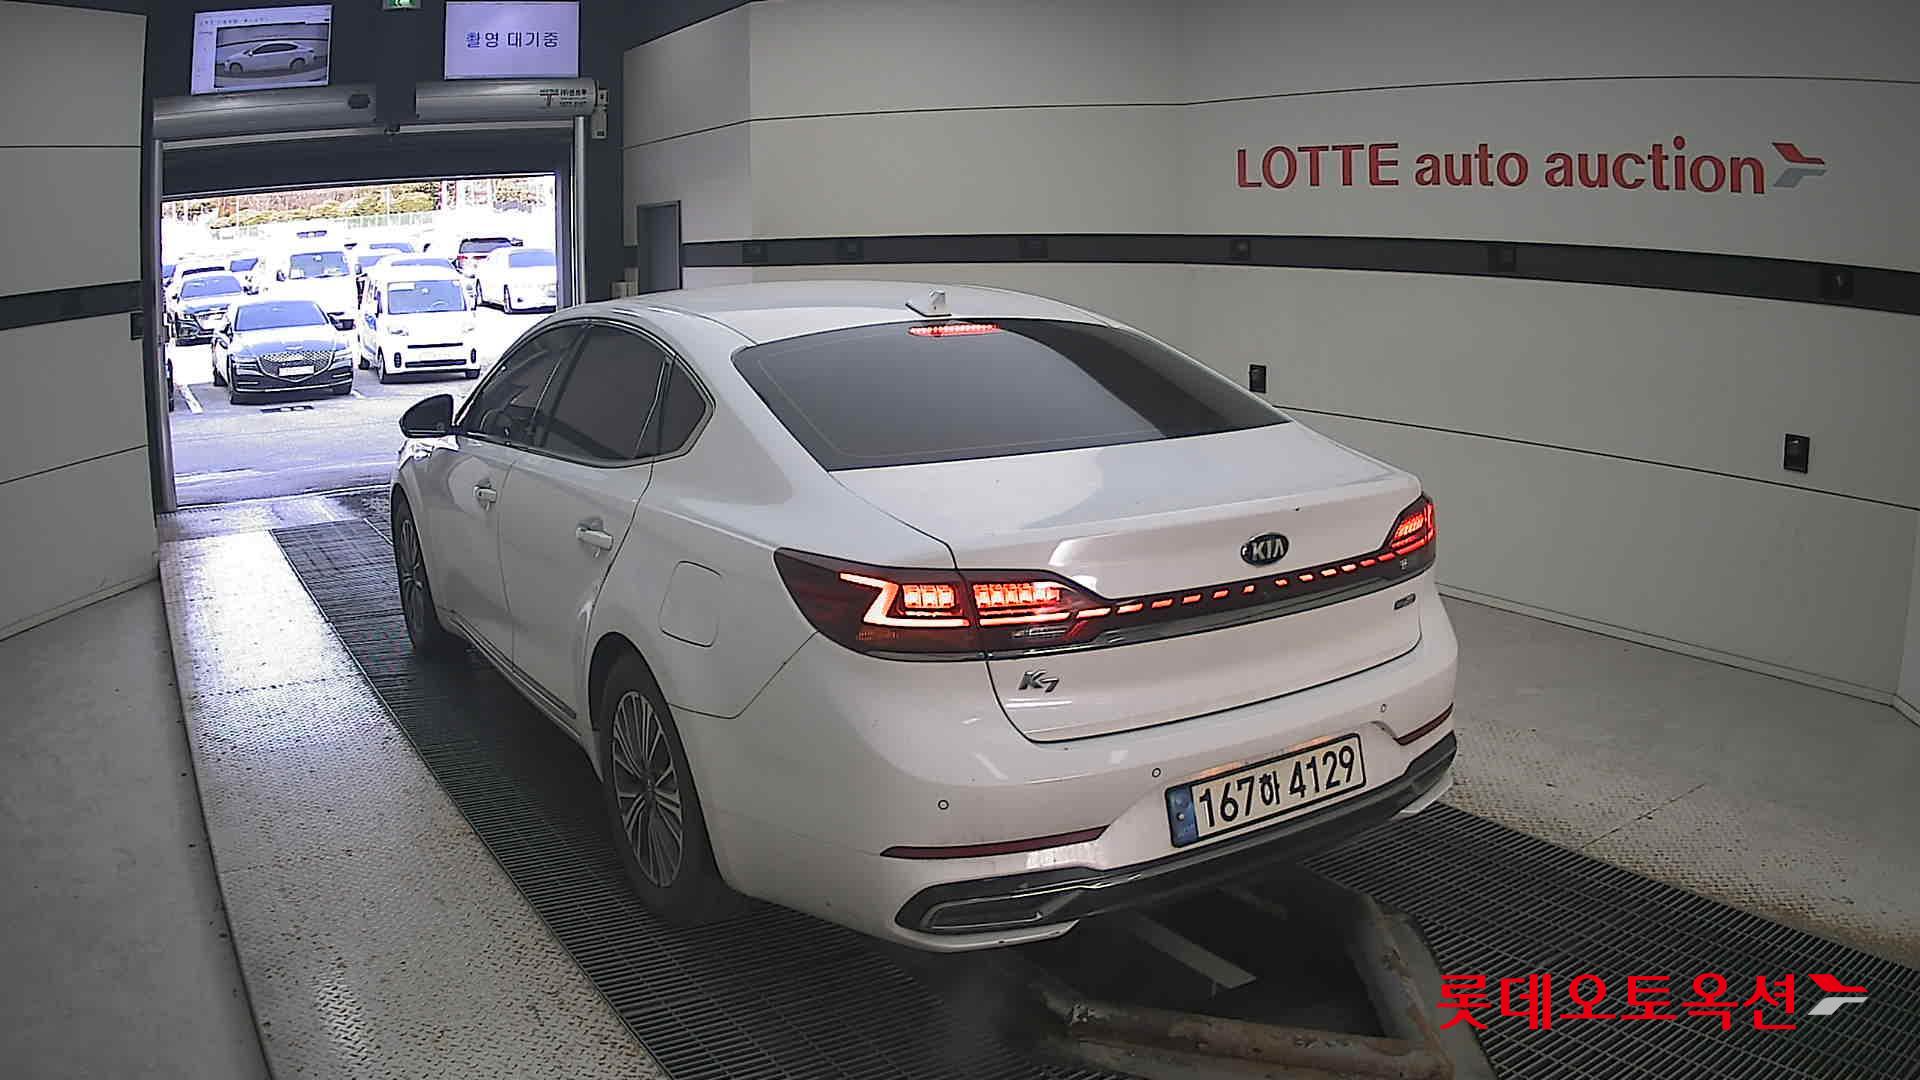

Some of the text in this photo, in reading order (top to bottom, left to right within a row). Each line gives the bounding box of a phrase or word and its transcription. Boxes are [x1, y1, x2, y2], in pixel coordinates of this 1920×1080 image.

[466, 32, 559, 48] 촬영 대기중
[1237, 136, 1766, 194] LOTTE auto auction
[1252, 539, 1285, 561] KIA
[1019, 670, 1059, 693] K7
[1199, 746, 1355, 827] 167하 4129
